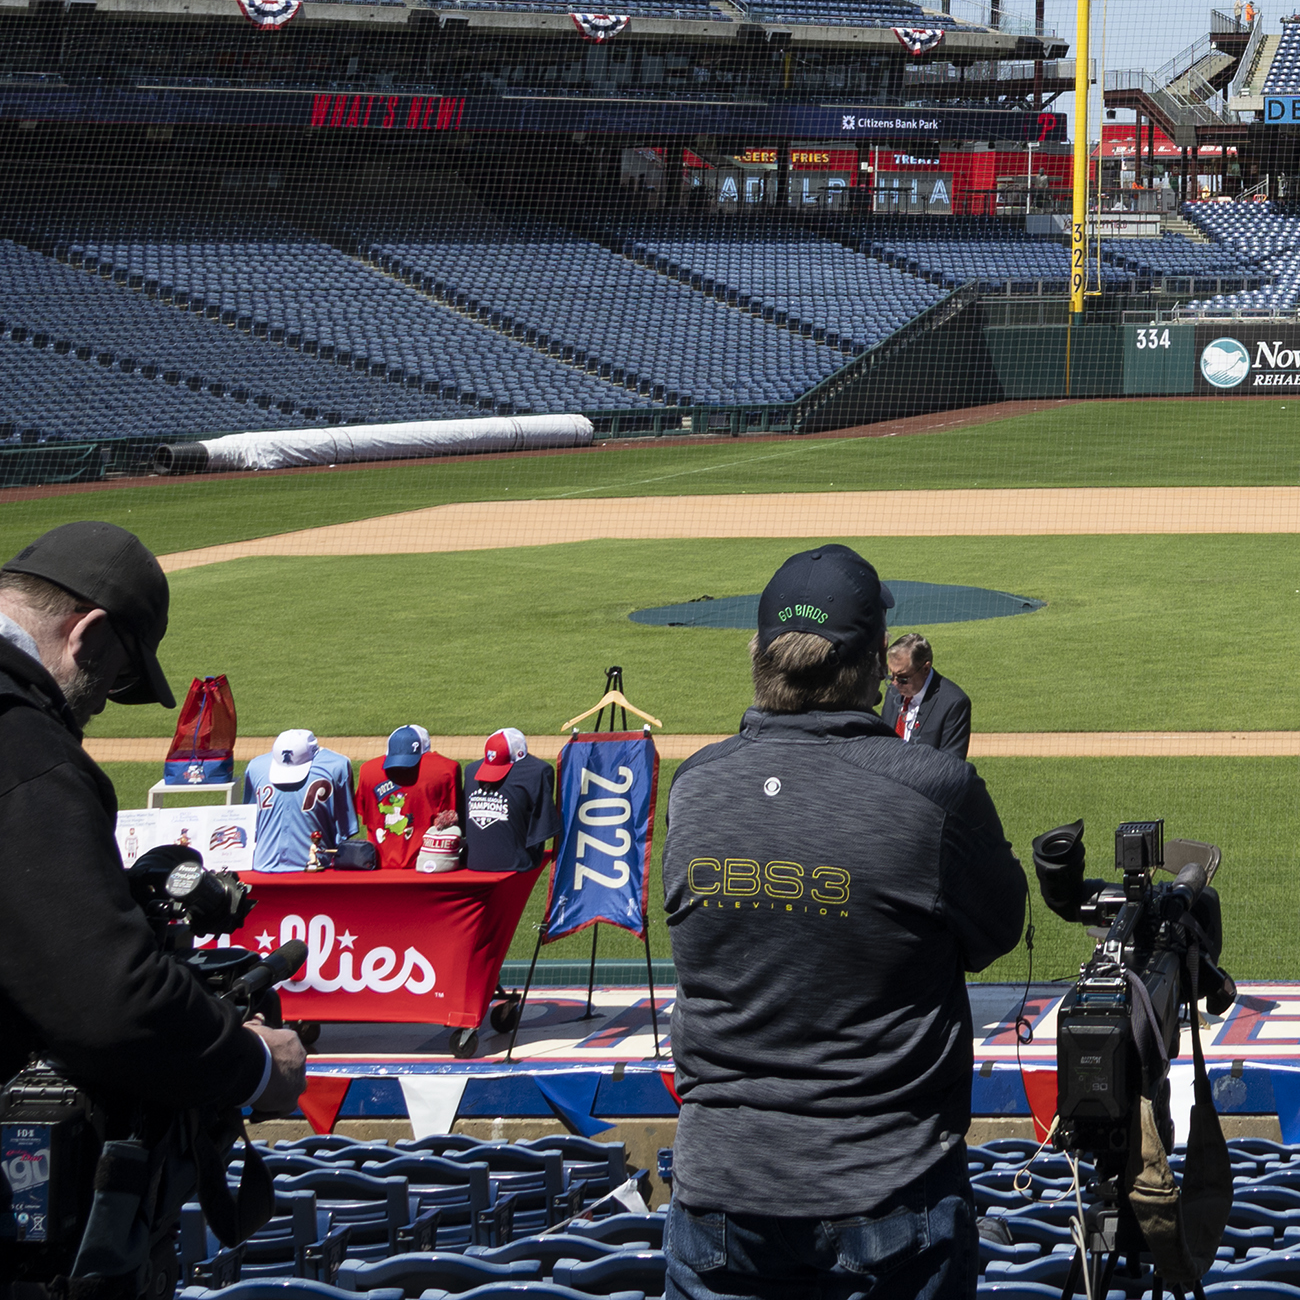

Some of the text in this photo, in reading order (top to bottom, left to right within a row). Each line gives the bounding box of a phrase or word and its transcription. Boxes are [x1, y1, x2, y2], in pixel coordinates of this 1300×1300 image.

[311, 94, 465, 130] WHAT'S NEW!
[858, 118, 938, 130] Citizens Bank Park
[792, 153, 829, 163] FRIES
[1135, 328, 1171, 349] 334
[778, 604, 828, 624] GO BIRDS
[302, 779, 334, 812] P
[376, 780, 395, 796] 2022
[468, 801, 508, 814] CHAMPIONS
[574, 766, 633, 890] 2022
[423, 837, 456, 849] PHILLIES
[688, 857, 851, 904] CBS 3
[689, 899, 849, 917] TELEVISION
